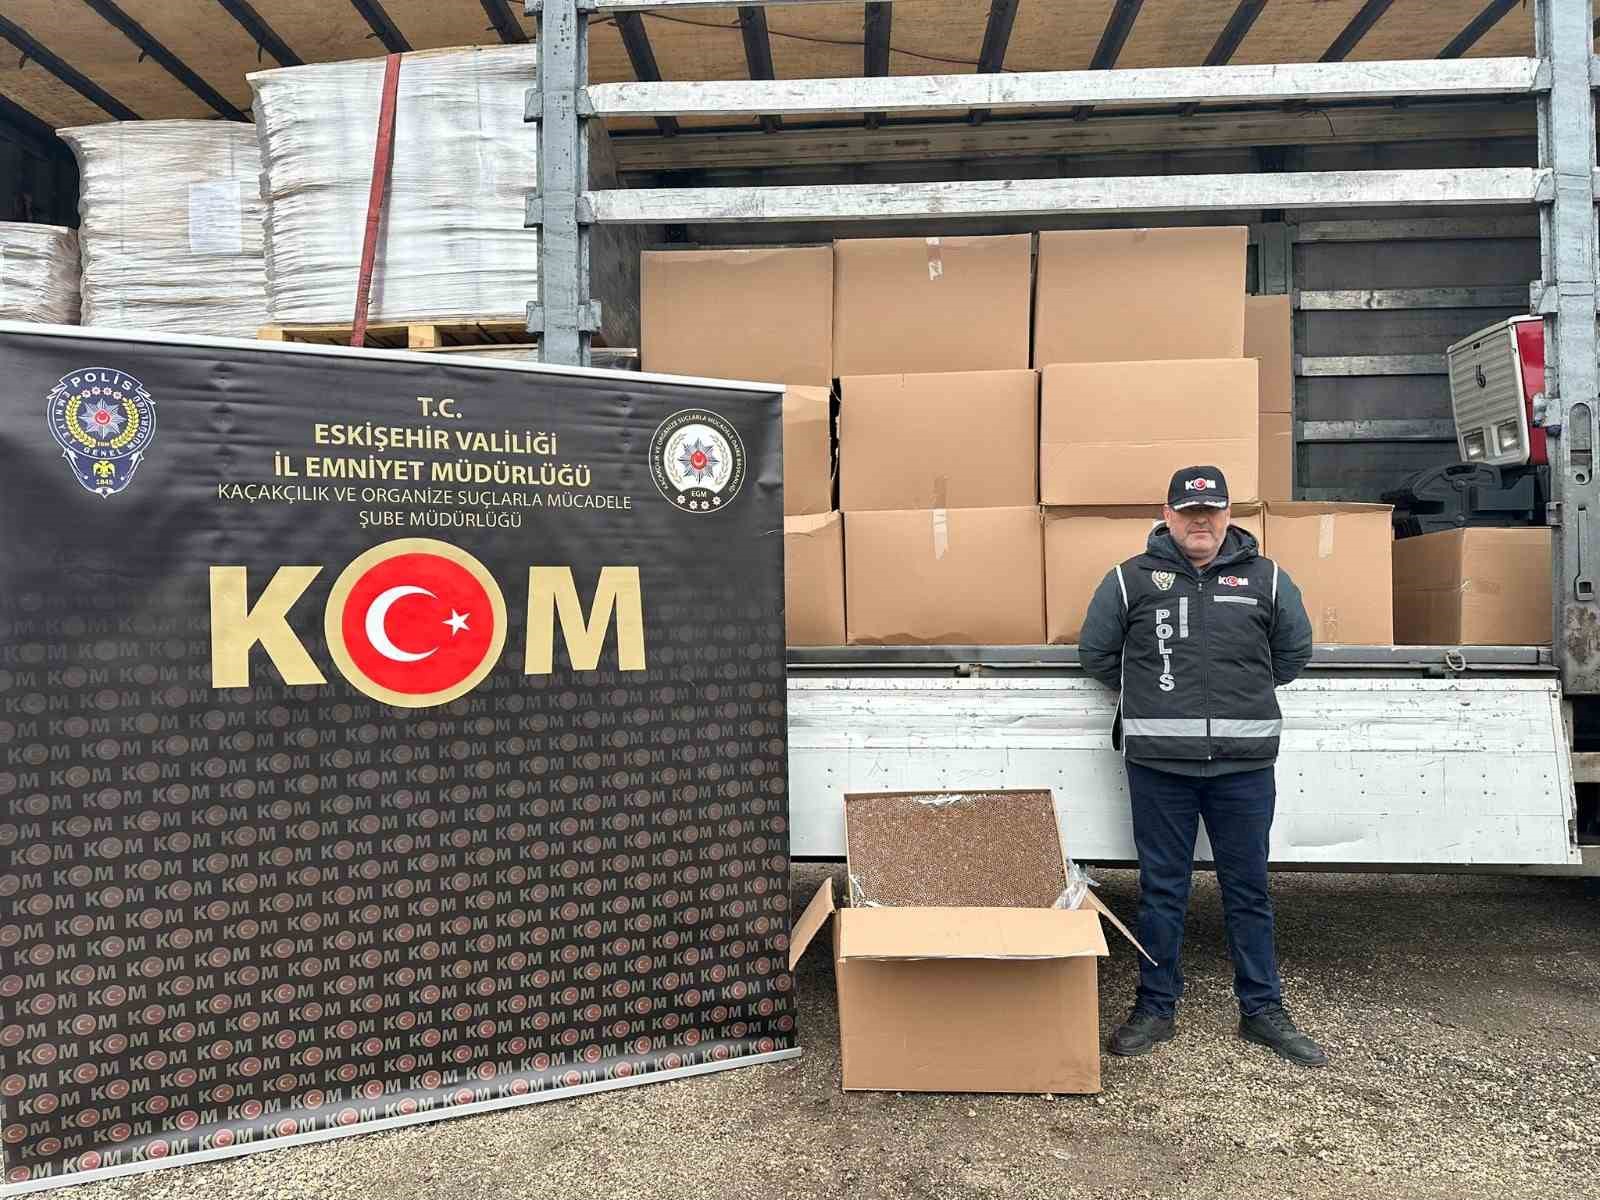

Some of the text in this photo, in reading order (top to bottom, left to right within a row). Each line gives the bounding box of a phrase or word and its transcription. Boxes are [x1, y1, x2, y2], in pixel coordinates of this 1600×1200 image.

[70, 372, 132, 390] POLİS
[417, 396, 463, 419] T.C.
[314, 422, 557, 455] ESKİŞEHİR VALİLİĞİ
[274, 451, 591, 487] İL EMNİYET MÜDÜRLÜĞÜ
[1185, 477, 1216, 490] KOM
[218, 484, 632, 510] KAÇAKÇILIK VE ORGANİZE SUÇLARLA MÜCADELE
[692, 490, 706, 498] EGM
[360, 509, 522, 529] ŞUBE MÜDÜRLÜĞÜ
[1218, 575, 1248, 587] KOM
[209, 538, 646, 708] KOM
[1156, 609, 1175, 692] POLİS
[54, 836, 780, 935] KOM KOM KOM KOM KOM KOM KOM KOM KOM KOM KOM KOM KOM
[55, 876, 781, 985] KOM KOM KOM KOM KOM KOM KOM KOM KOM KOM KOM KOM KOM
[56, 916, 782, 1035] KOM KOM KOM KOM KOM KOM KOM KOM KOM KOM KOM KOM KOM
[58, 956, 783, 1084] KOM KOM KOM KOM KOM KOM KOM KOM KOM KOM KOM KOM KOM
[61, 997, 786, 1129] KOM KOM KOM KOM KOM KOM KOM KOM KOM KOM KOM KOM KOM
[62, 1035, 786, 1170] KOM KOM KOM KOM KOM KOM KOM KOM KOM KOM KOM KOM KOM
